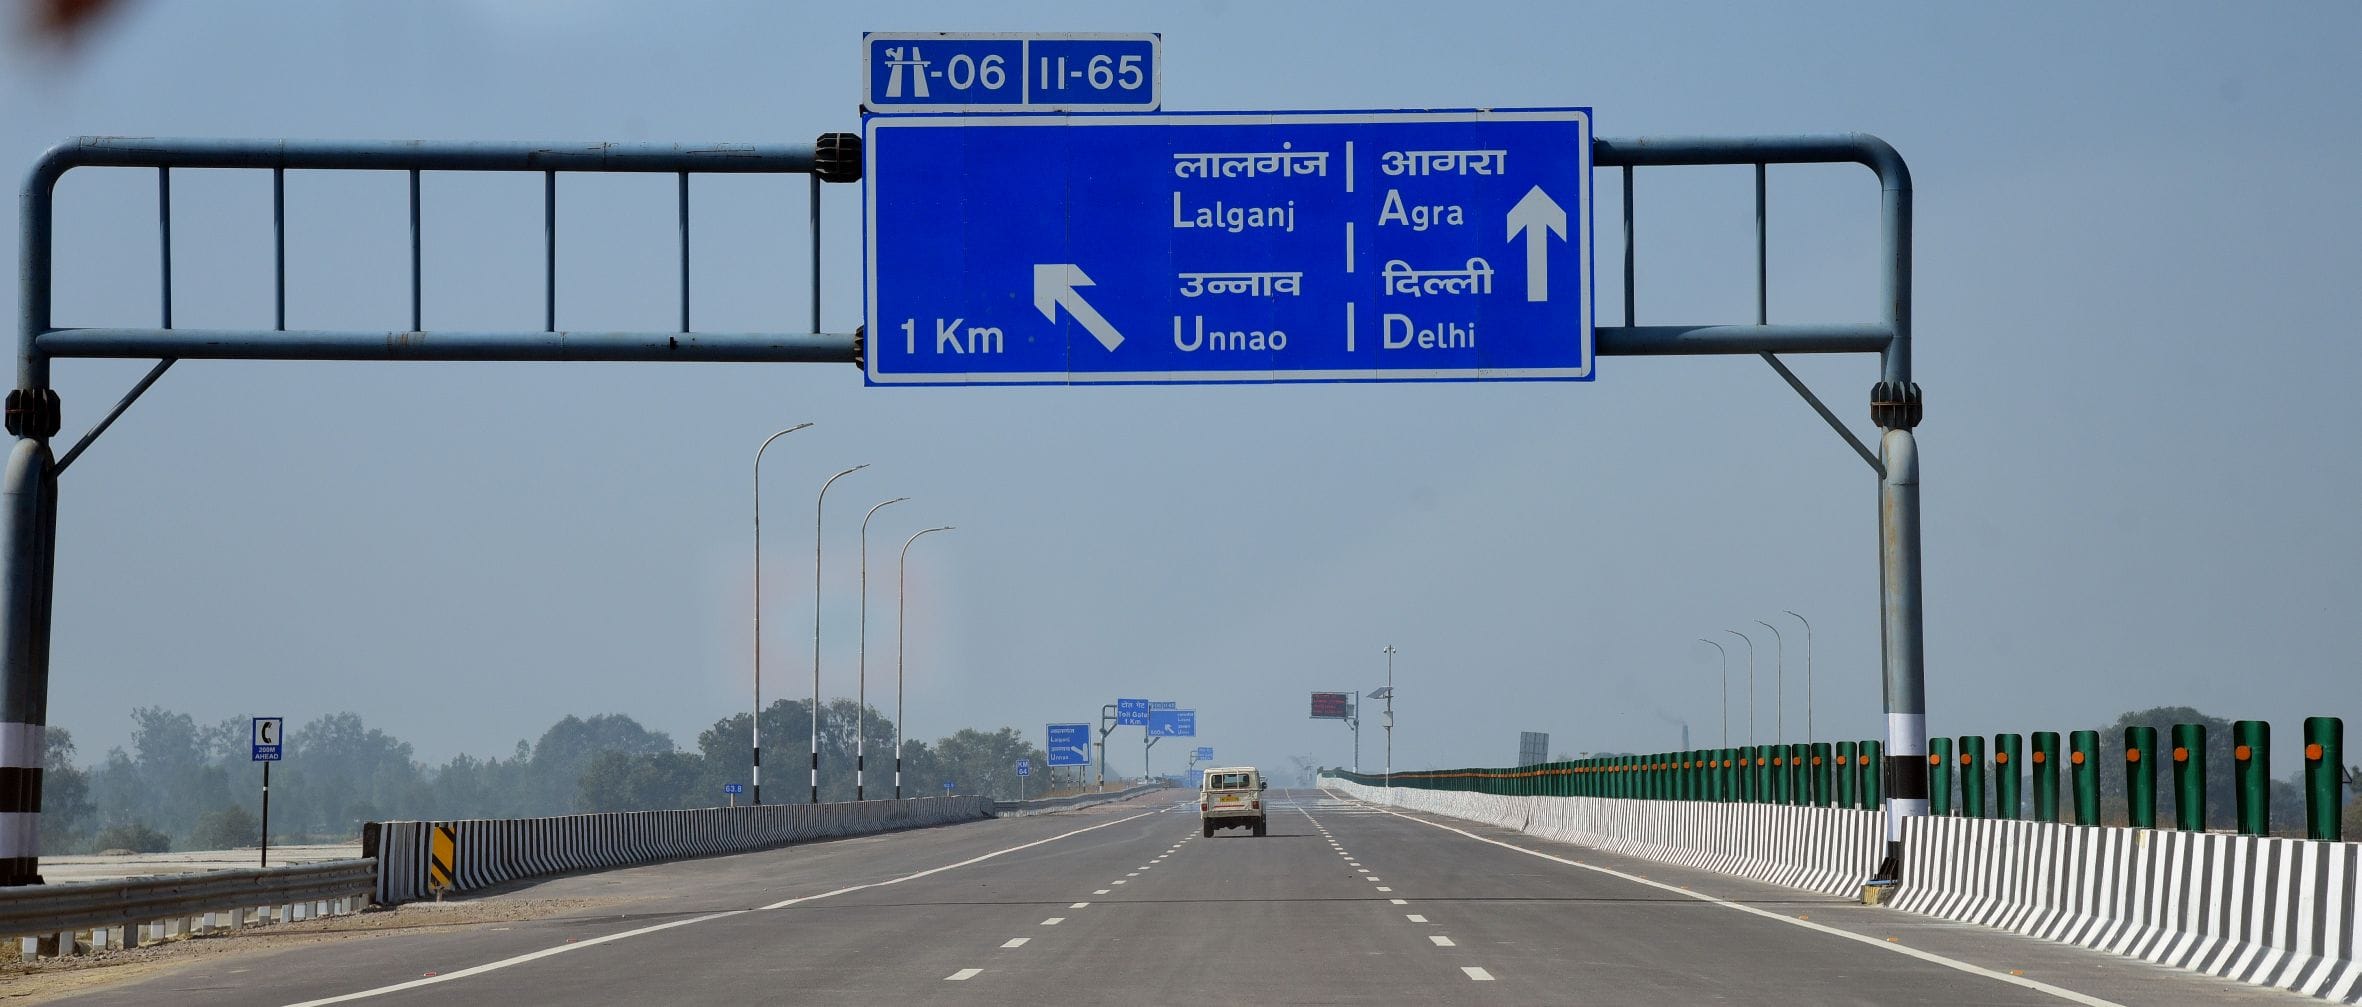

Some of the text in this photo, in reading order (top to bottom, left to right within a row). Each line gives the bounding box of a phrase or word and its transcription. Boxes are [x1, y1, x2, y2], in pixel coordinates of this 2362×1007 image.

[1173, 141, 1330, 178] लालगंज
[1381, 149, 1507, 177] आगरा
[1173, 191, 1295, 233] Lalganj
[1378, 189, 1464, 232] Agra
[1178, 271, 1303, 298] उन्नाव
[1381, 257, 1495, 298] दिल्ली
[900, 317, 1004, 355] 1 Km
[1174, 315, 1288, 352] Unnao
[1383, 313, 1476, 350] Delhi
